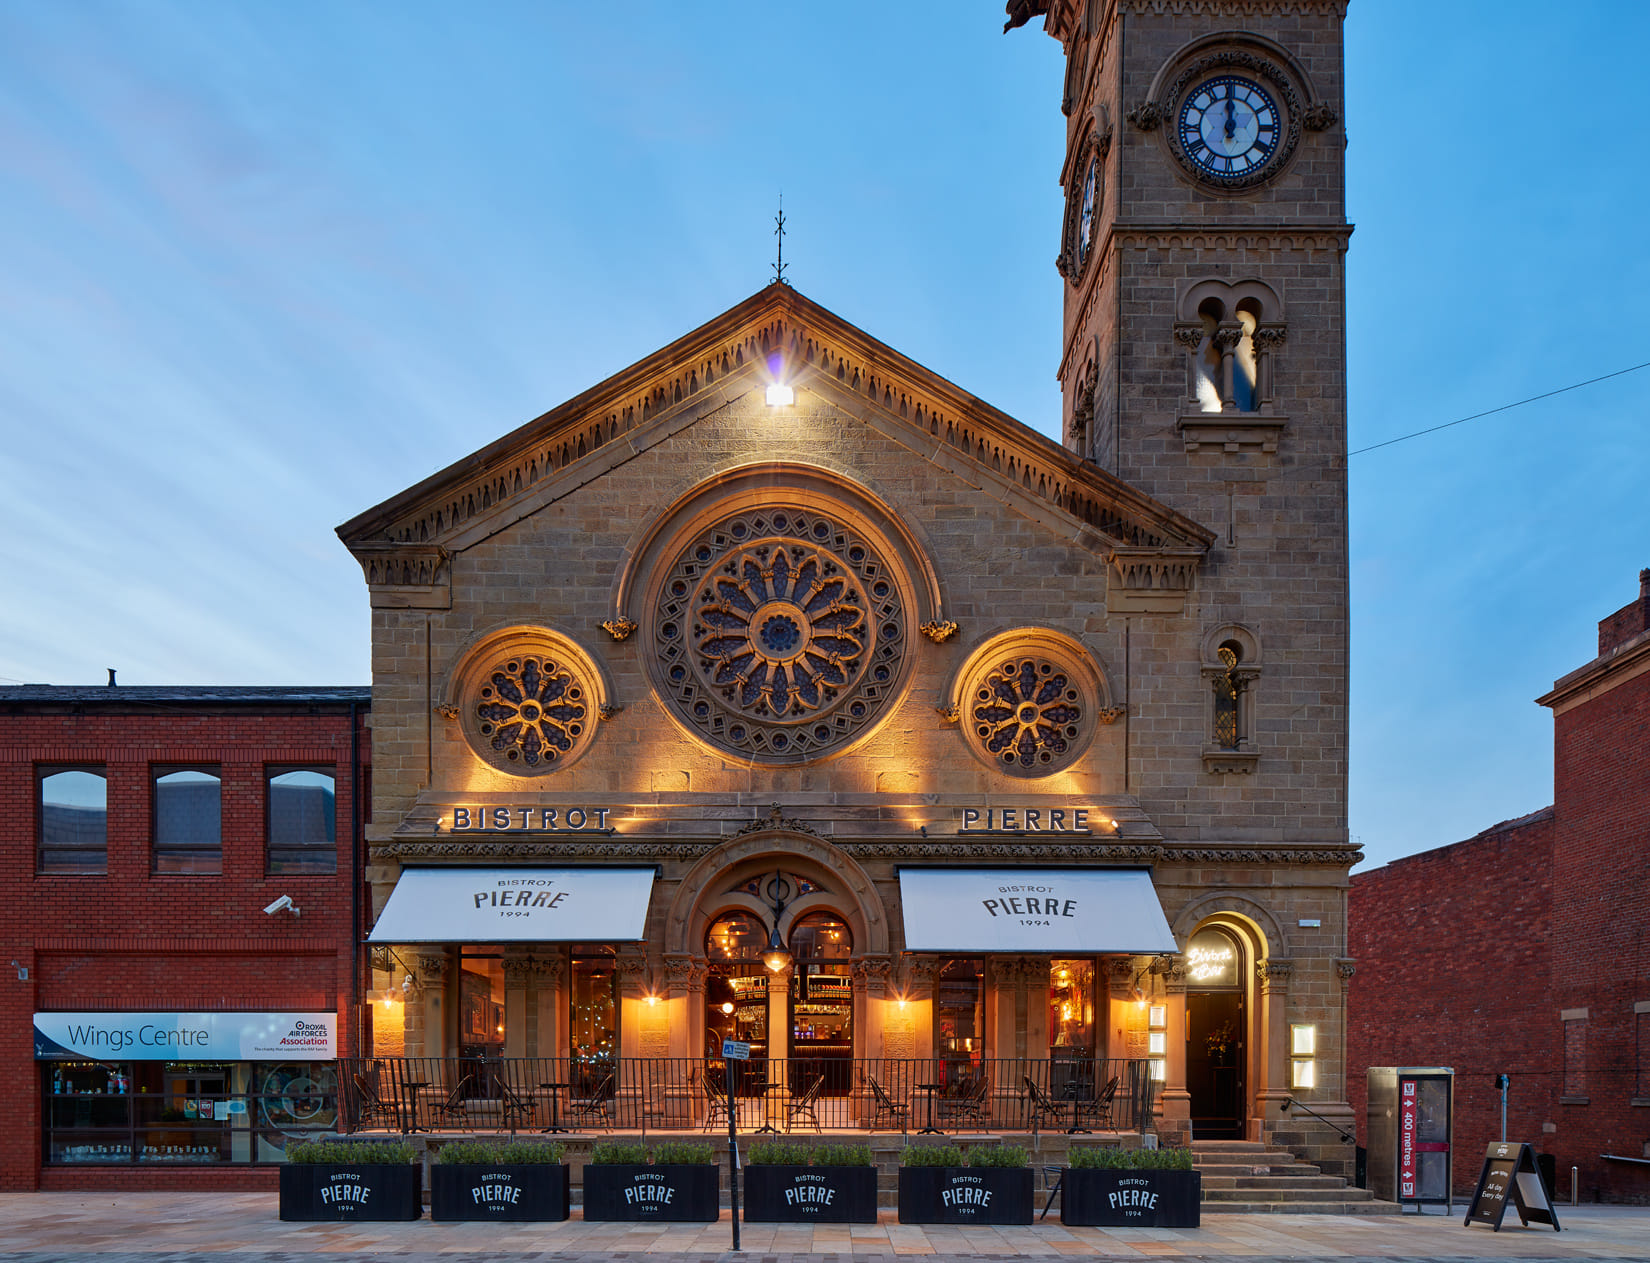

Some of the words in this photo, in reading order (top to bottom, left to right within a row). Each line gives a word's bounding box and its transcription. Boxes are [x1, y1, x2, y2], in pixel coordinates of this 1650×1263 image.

[453, 807, 611, 830] BISTROT
[962, 808, 1089, 831] PIERRE
[998, 885, 1054, 893] BISTROT
[474, 890, 570, 909] PIERRE
[982, 897, 1078, 918] PIERRE
[68, 1025, 134, 1051] Wings
[139, 1025, 209, 1046] Centre
[280, 1037, 328, 1045] Association
[1404, 1111, 1413, 1130] 400
[1404, 1132, 1413, 1166] metres
[330, 1173, 361, 1181] BISTROT
[481, 1173, 512, 1181] BISTROT
[634, 1173, 665, 1181] BISTROT
[795, 1174, 826, 1182] BISTROT
[952, 1176, 983, 1184] BISTROT
[1118, 1178, 1150, 1186] BISTROT
[320, 1184, 371, 1204] PIERRE
[471, 1184, 522, 1204] PIERRE
[624, 1184, 675, 1204] PIERRE
[785, 1186, 836, 1206] PIERRE
[942, 1187, 993, 1207] PIERRE
[1481, 1191, 1496, 1200] Every
[1494, 1193, 1504, 1201] day
[1494, 1184, 1503, 1192] day
[1108, 1189, 1159, 1210] PIERRE
